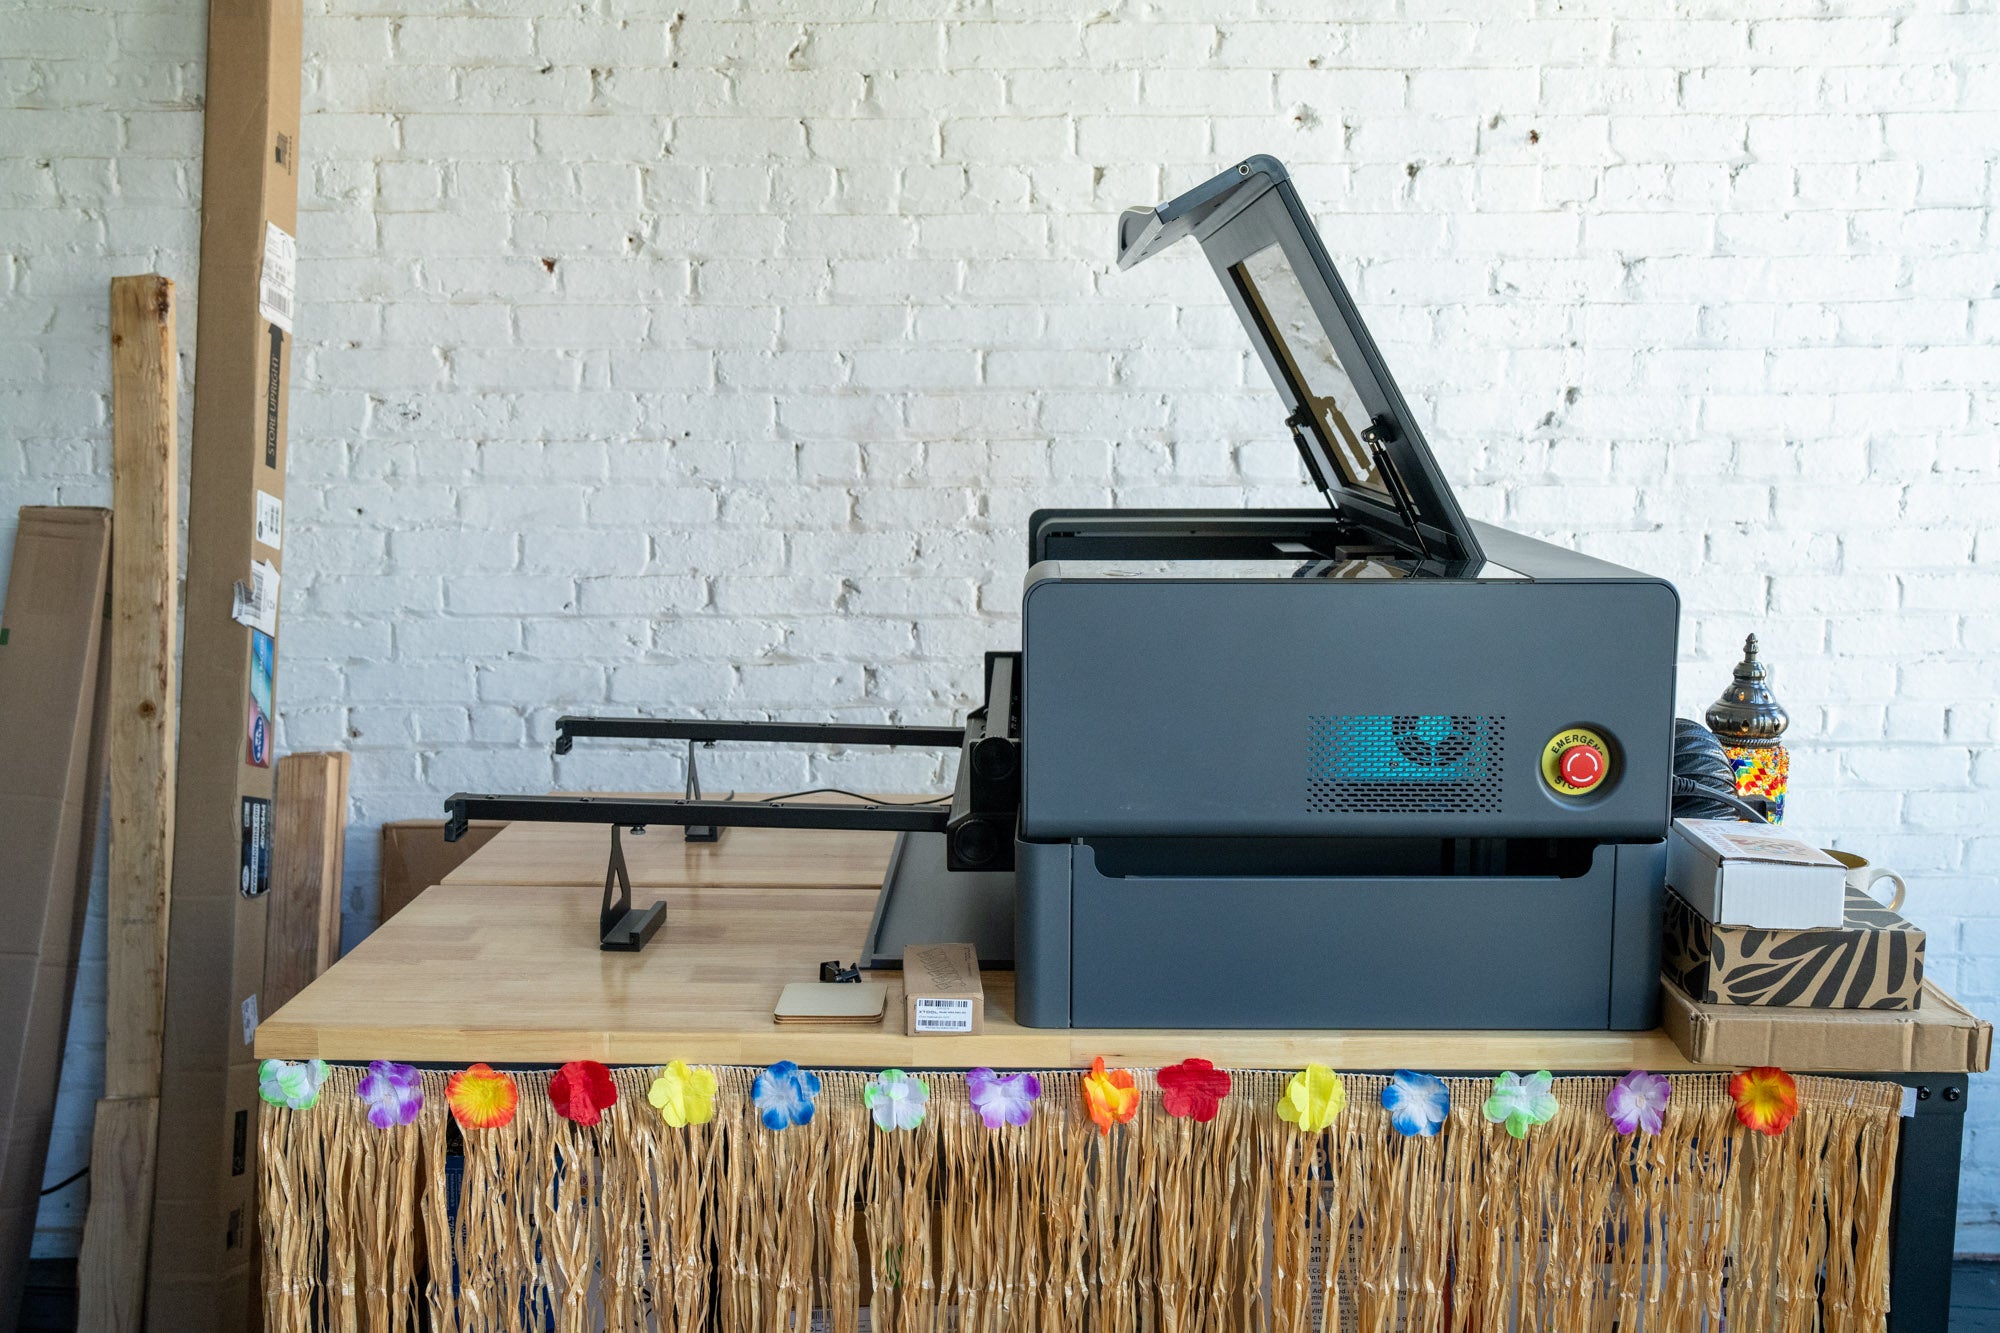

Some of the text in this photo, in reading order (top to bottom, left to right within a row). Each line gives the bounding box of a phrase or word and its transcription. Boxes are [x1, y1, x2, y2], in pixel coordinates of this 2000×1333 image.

[267, 355, 279, 456] STORE UPRIGHT
[251, 804, 260, 893] www.adorama.com
